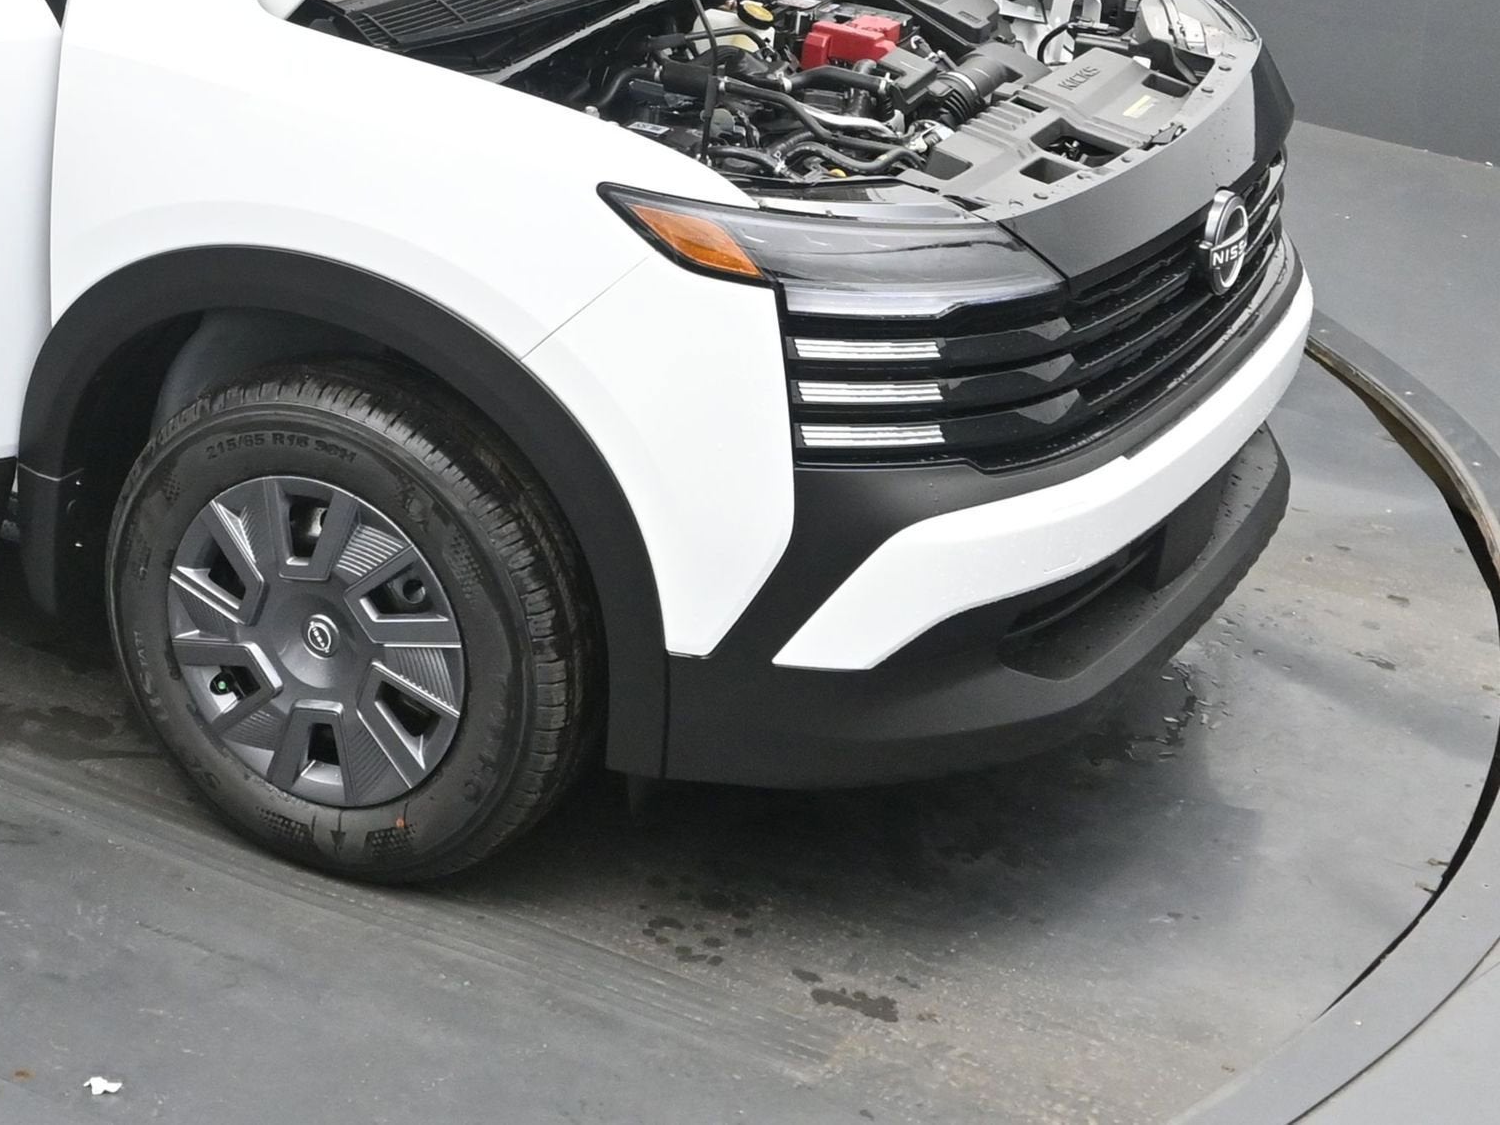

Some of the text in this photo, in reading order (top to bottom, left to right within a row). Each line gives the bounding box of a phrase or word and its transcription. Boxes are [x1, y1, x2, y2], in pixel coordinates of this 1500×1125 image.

[1058, 66, 1101, 90] KICKS
[1212, 239, 1248, 267] NISS
[205, 433, 265, 460] 215/65
